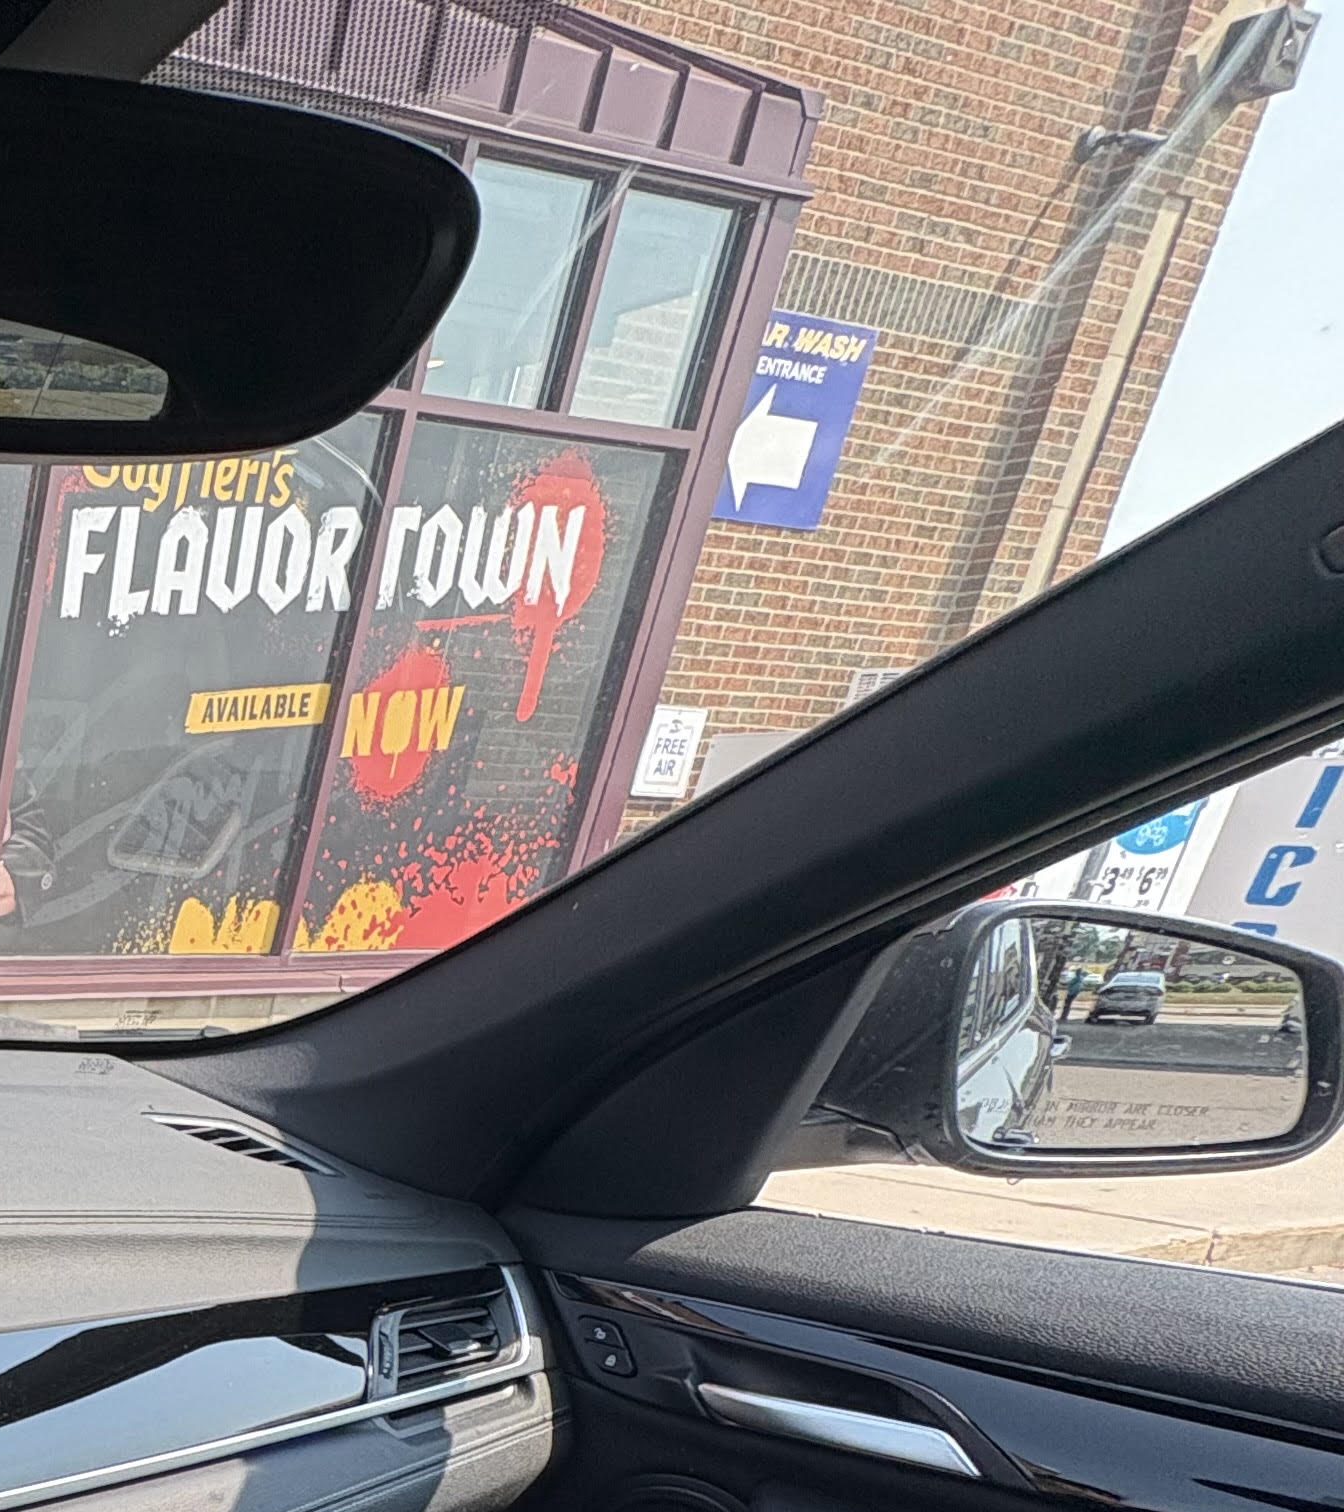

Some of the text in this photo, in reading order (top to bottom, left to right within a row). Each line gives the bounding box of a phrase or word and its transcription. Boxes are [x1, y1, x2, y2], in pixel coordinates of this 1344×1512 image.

[794, 327, 867, 363] WASH
[755, 356, 828, 384] ENTRANCE
[201, 685, 465, 758] AVAILABLE NOW
[654, 737, 687, 755] FREE
[653, 759, 676, 776] AIR
[1124, 1103, 1148, 1115] ARE
[1157, 1105, 1209, 1116] CLOSER
[1103, 1117, 1158, 1130] APPEAR
